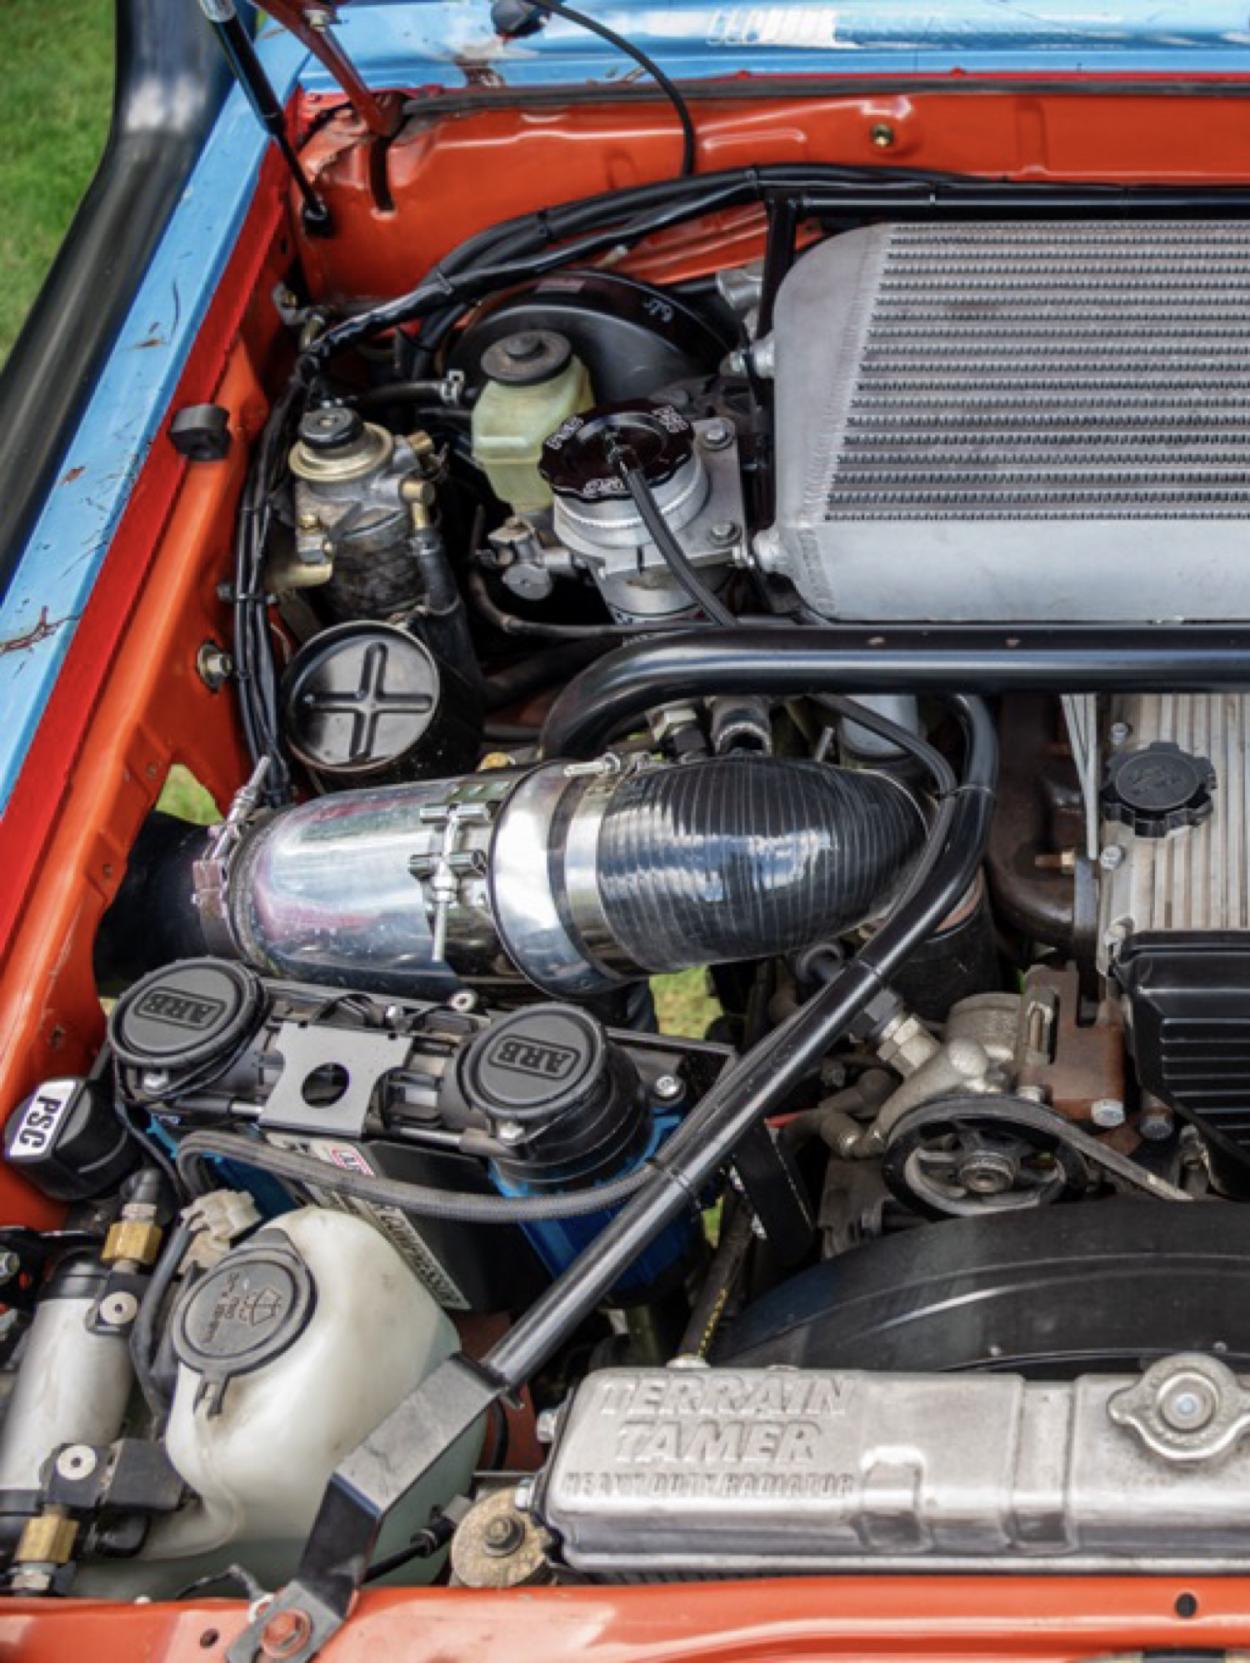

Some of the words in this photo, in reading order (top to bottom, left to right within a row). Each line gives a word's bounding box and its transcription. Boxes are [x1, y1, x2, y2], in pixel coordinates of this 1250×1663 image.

[143, 993, 219, 1024] ARB
[498, 1041, 572, 1074] ARB
[19, 1095, 62, 1148] PSC
[600, 1376, 853, 1415] TERRAIN
[616, 1419, 822, 1463] TAMER
